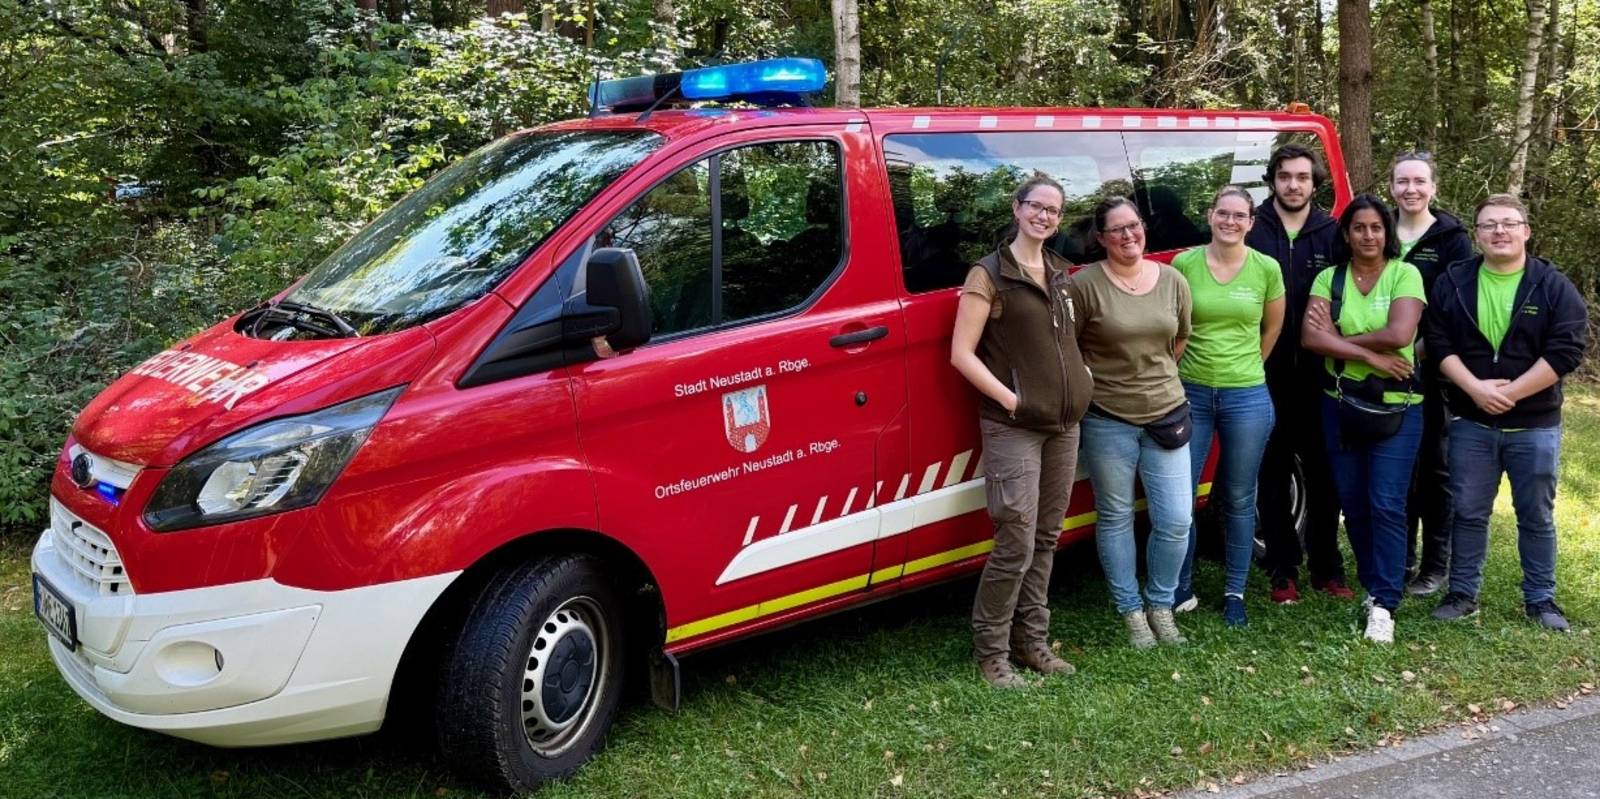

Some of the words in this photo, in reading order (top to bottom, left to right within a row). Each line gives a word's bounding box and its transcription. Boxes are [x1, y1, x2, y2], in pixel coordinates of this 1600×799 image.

[674, 380, 707, 397] Stadt
[709, 368, 762, 390] Neustadt
[765, 366, 776, 376] a.
[778, 357, 812, 374] Rbge.
[654, 466, 740, 499] Ortsfeuerwehr
[743, 450, 794, 475] Neustadt
[796, 449, 807, 458] a.
[809, 438, 841, 454] Rbge.
